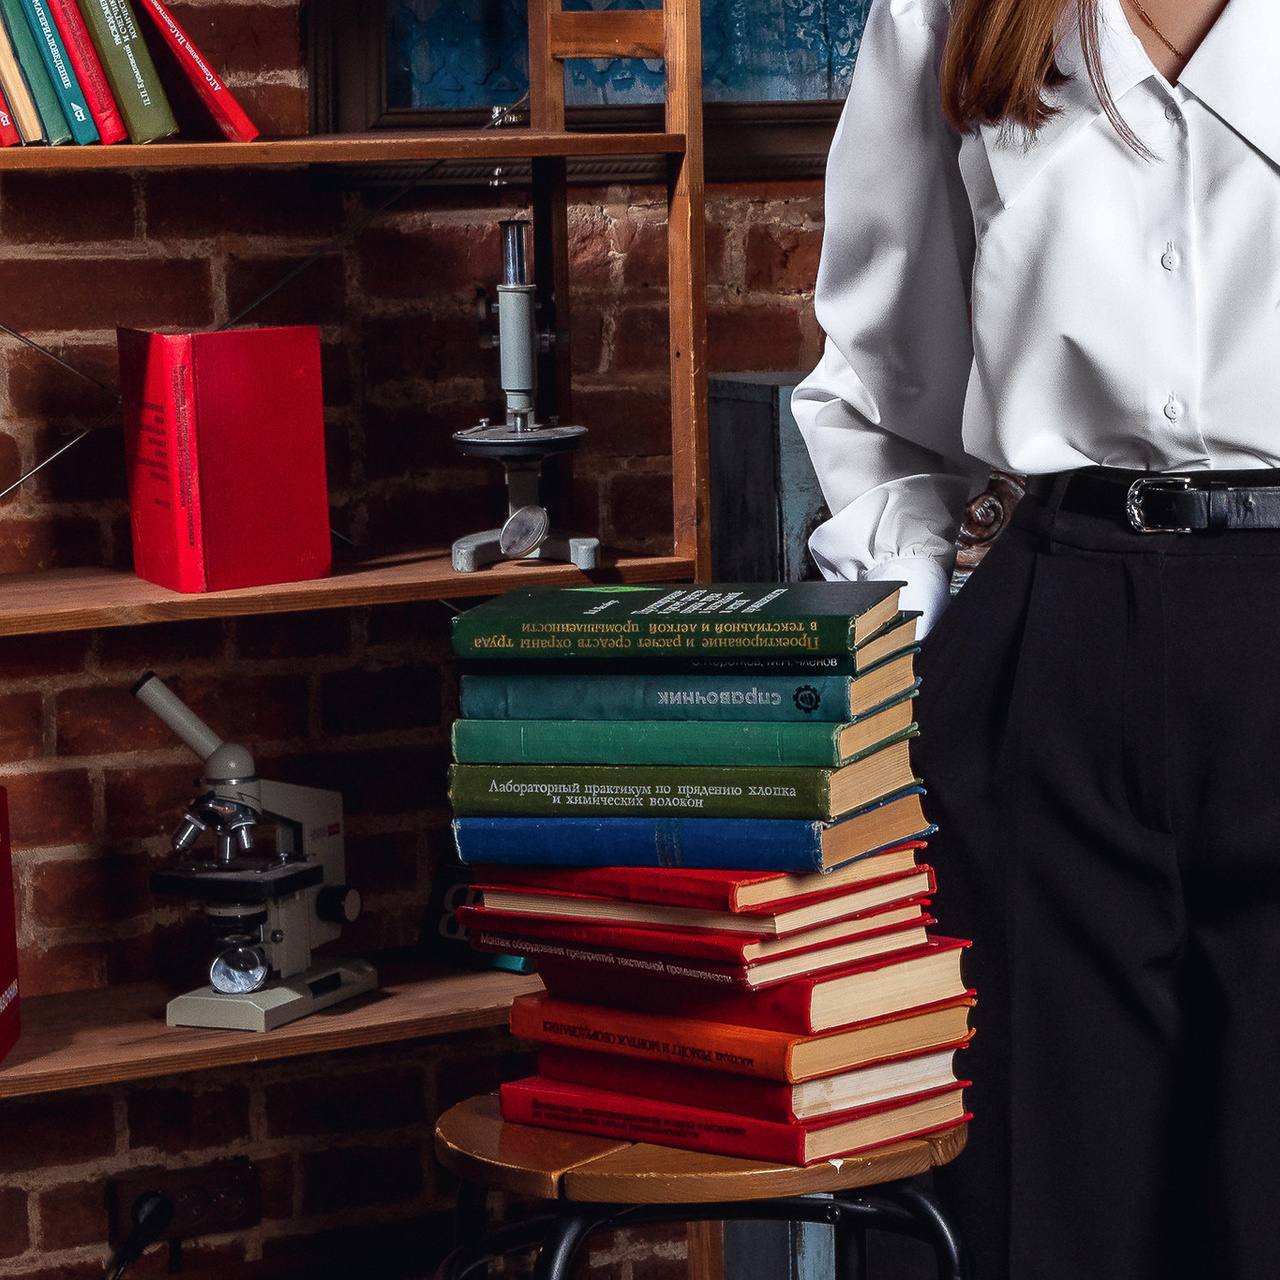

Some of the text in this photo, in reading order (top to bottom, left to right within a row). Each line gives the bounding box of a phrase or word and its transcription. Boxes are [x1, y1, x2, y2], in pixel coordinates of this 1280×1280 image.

[521, 622, 818, 634] в текстильной и легкой промышленности
[474, 634, 820, 651] Проектирование и расчет средств охраны труда
[657, 687, 782, 706] справочник
[488, 779, 797, 797] Лабораторный практикум по прядению хлопка
[552, 795, 704, 808] и химических волокон
[480, 932, 733, 984] Монтаж оборудования предприятий текстильной промышленности
[542, 1020, 617, 1045] ОБОРУДОВАНИЯ
[618, 1035, 661, 1052] МОНТАЖ
[661, 1043, 670, 1053] И
[671, 1045, 712, 1062] РЕМОНТ
